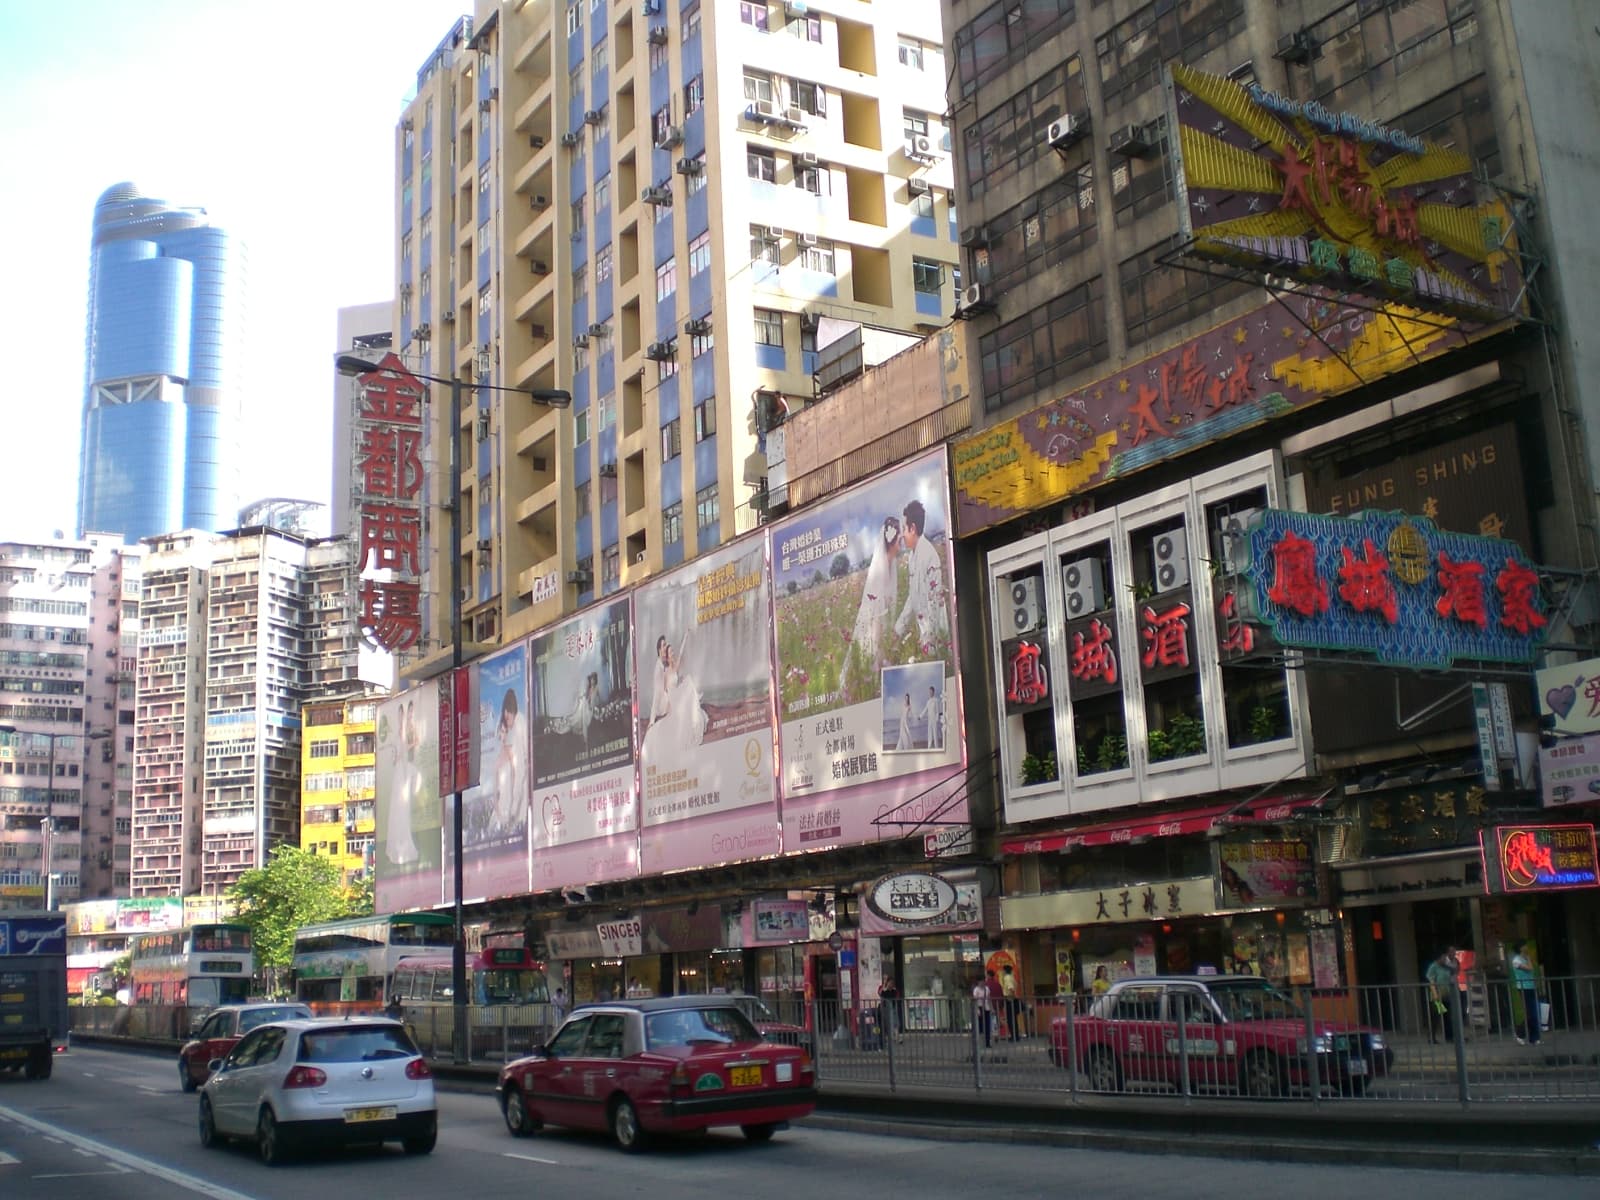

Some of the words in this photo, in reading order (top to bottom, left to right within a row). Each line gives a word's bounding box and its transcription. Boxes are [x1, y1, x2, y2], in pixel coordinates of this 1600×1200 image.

[1127, 343, 1256, 446] 太陽城
[1330, 479, 1395, 512] FUNG
[1415, 444, 1498, 487] SHING
[357, 351, 425, 650] 金都商場
[1268, 529, 1548, 635] 鳳城酒家
[832, 752, 878, 780] 婚悅展覽館
[1265, 806, 1291, 820] Coca-Cola
[1110, 829, 1132, 842] Coca-Cola
[1159, 822, 1181, 836] Coca-Cola
[1024, 841, 1042, 853] Coca-Cola
[1508, 832, 1557, 879] 太陽城
[891, 878, 939, 893] 太子冰室
[1096, 884, 1182, 920] 太子冰室
[600, 920, 641, 941] SINGER
